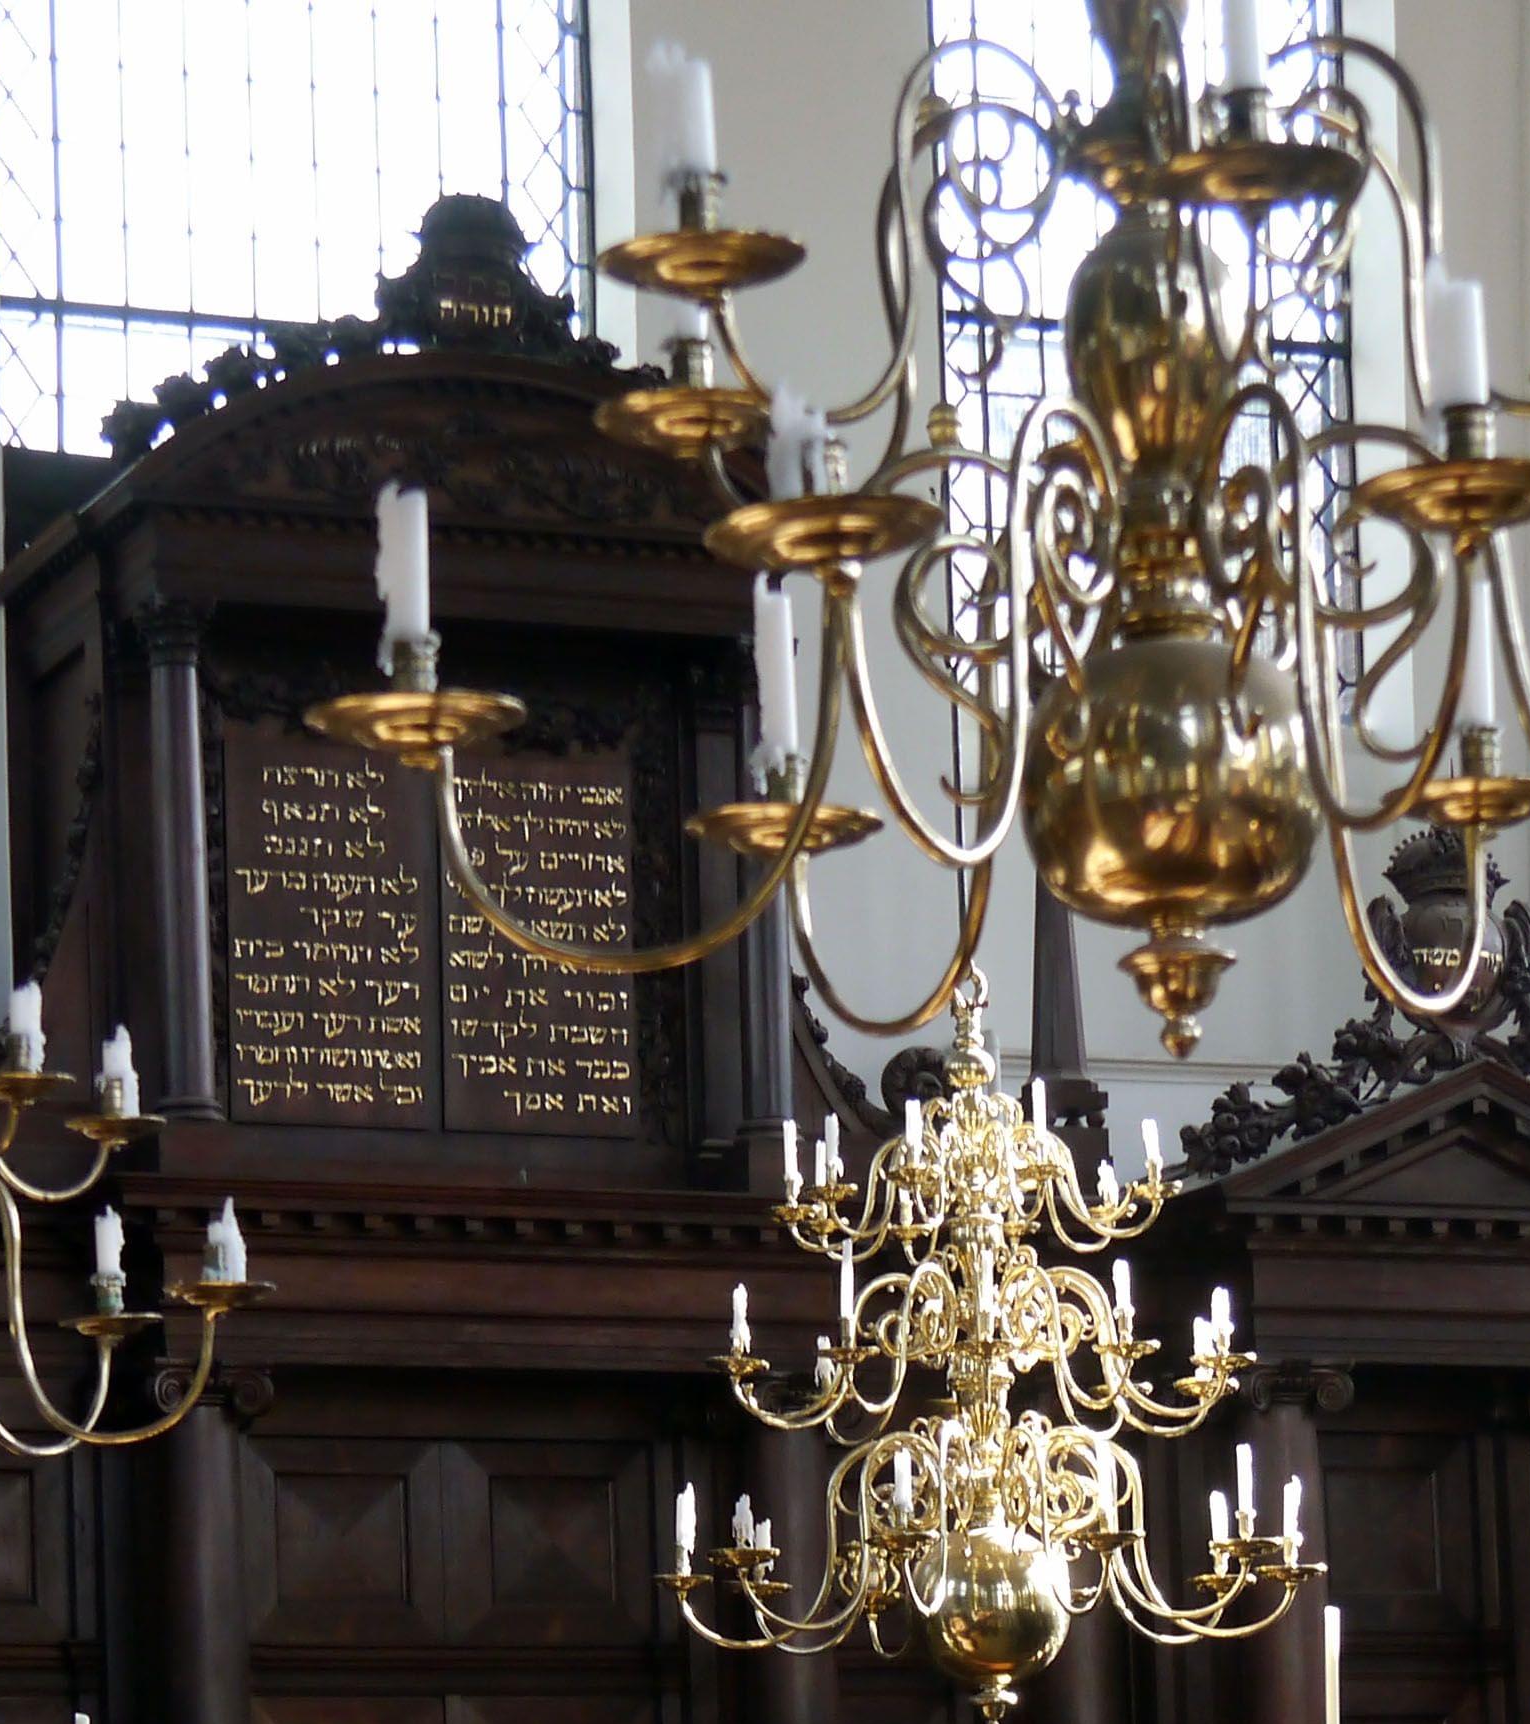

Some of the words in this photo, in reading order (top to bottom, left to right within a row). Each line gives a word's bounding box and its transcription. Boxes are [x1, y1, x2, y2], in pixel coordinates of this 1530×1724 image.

[439, 298, 512, 328] תורה
[263, 765, 339, 789] תרצח
[346, 757, 385, 789] לא
[262, 799, 340, 826] תנאף
[349, 793, 386, 824] לא
[513, 809, 544, 842] לך
[593, 816, 626, 839] לא
[345, 826, 385, 858] לא
[495, 834, 529, 876] על
[234, 868, 308, 895] ברעך
[381, 863, 418, 895] לא
[490, 872, 522, 909] לך
[594, 881, 627, 908] לא
[299, 906, 364, 937] שקר
[377, 911, 418, 940] עד
[593, 917, 626, 942] לא
[234, 938, 285, 959] בית
[380, 939, 420, 964] לא
[449, 940, 504, 970] לשוא
[1412, 947, 1462, 967] משה
[319, 965, 357, 996] לא
[365, 979, 420, 1006] רעך
[449, 984, 490, 1003] יום
[505, 988, 549, 1008] את
[563, 989, 629, 1011] זכור
[313, 1012, 362, 1039] רעך
[369, 1016, 421, 1035] אשת
[451, 1009, 537, 1049] לקדשו
[549, 1022, 628, 1046] השבת
[452, 1053, 517, 1080] אביך
[526, 1057, 567, 1077] את
[575, 1058, 630, 1080] כבד
[237, 1067, 309, 1106] לרעך
[316, 1083, 374, 1103] אשר
[380, 1071, 423, 1105] וכל
[503, 1089, 564, 1116] אמך
[577, 1092, 632, 1115] ואת
